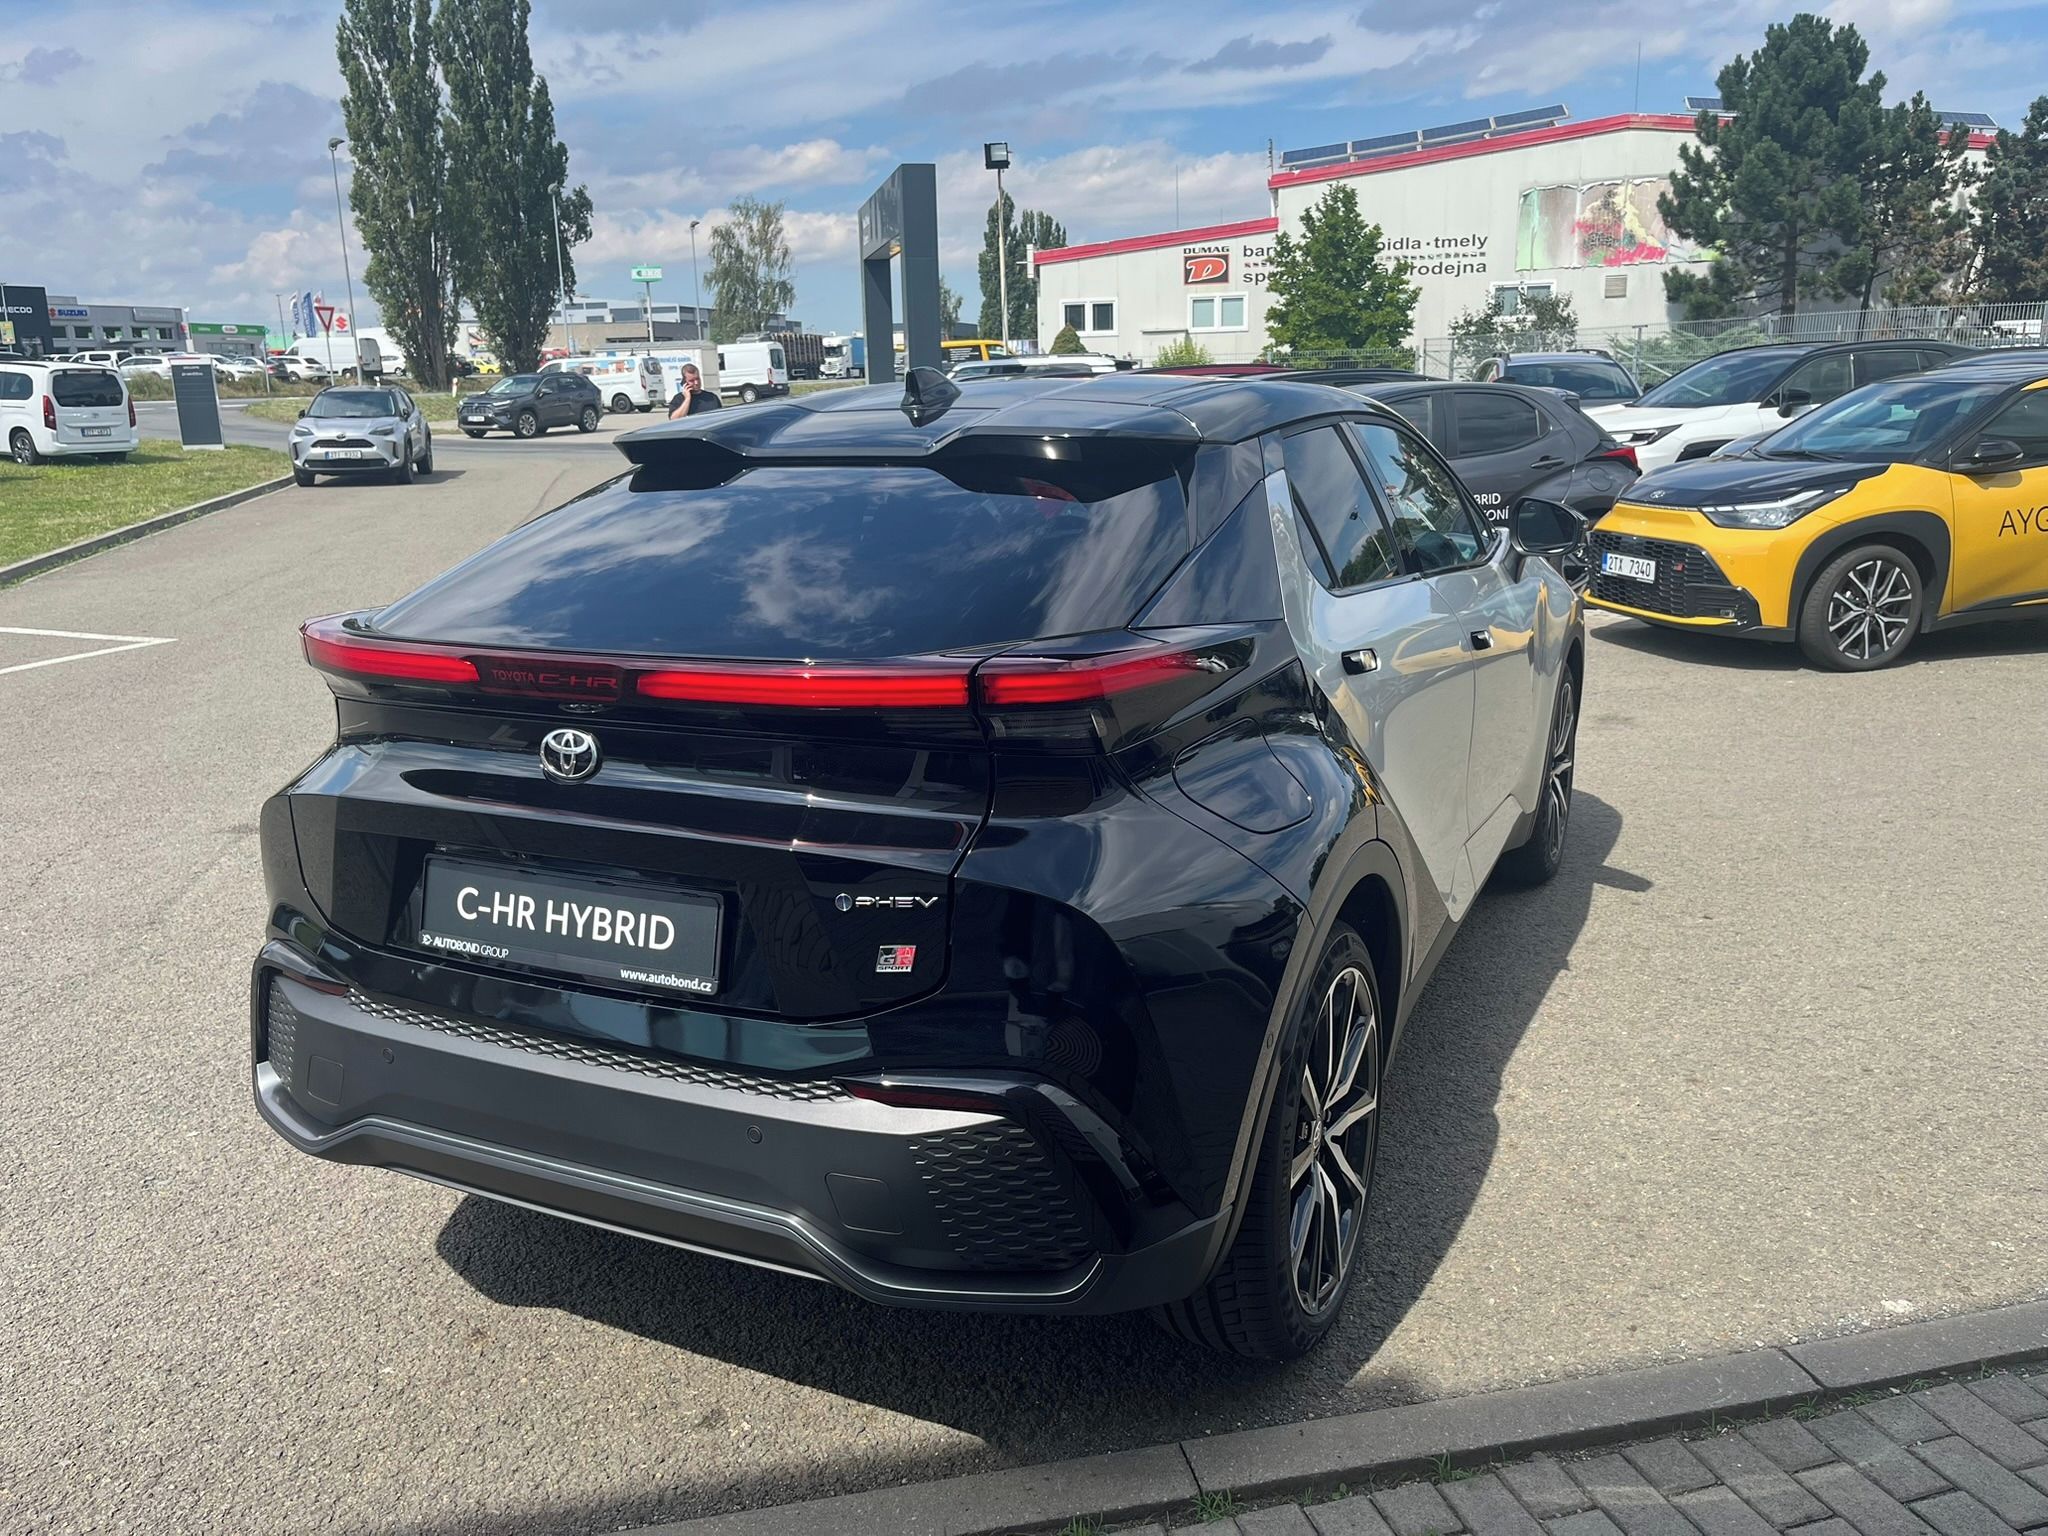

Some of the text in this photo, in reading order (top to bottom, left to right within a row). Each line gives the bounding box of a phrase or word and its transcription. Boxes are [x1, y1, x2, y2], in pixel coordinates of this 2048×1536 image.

[1184, 246, 1230, 254] DUMAG
[1434, 234, 1488, 249] tmely
[58, 309, 88, 317] SUZUKI
[1483, 505, 1510, 521] ONÍ
[1608, 556, 1651, 577] 2TX 7340
[491, 669, 618, 688] TOYOTA C-HR
[855, 896, 939, 908] PHEV
[456, 886, 675, 950] C-HR HYBRID
[433, 936, 509, 958] AUTOBOND GROUP
[620, 968, 713, 992] www.autobond.cz
